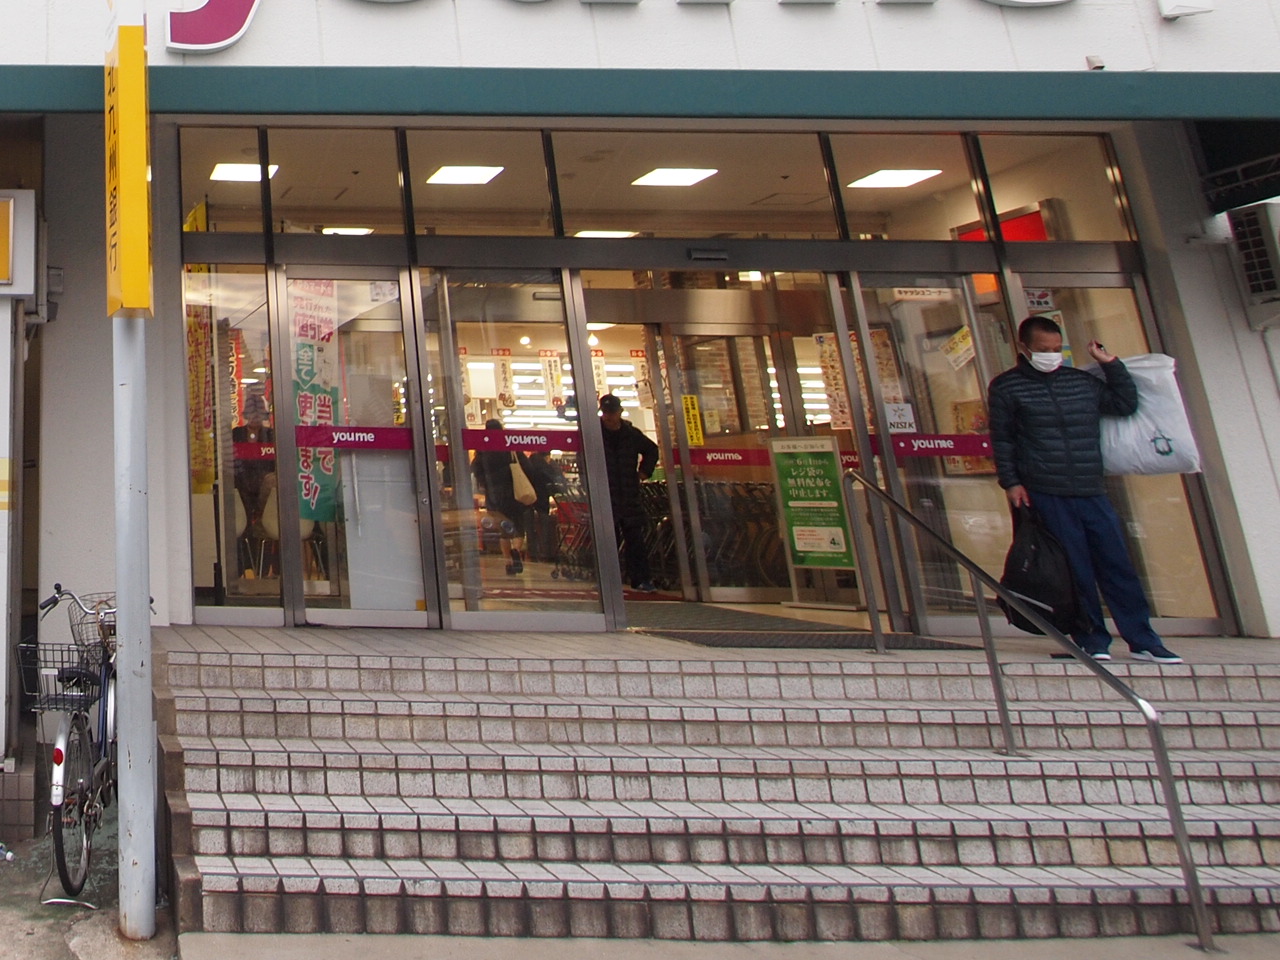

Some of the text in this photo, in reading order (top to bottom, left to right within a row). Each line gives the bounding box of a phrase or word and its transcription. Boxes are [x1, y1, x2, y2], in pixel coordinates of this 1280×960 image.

[106, 58, 118, 274] 北九州銀行
[293, 295, 332, 313] 発行された
[298, 346, 313, 380] 全て
[317, 393, 335, 475] 当で
[332, 431, 375, 443] youme
[505, 435, 547, 446] youme
[911, 439, 955, 450] youme
[706, 452, 742, 462] youme
[791, 468, 824, 477] レジ袋の
